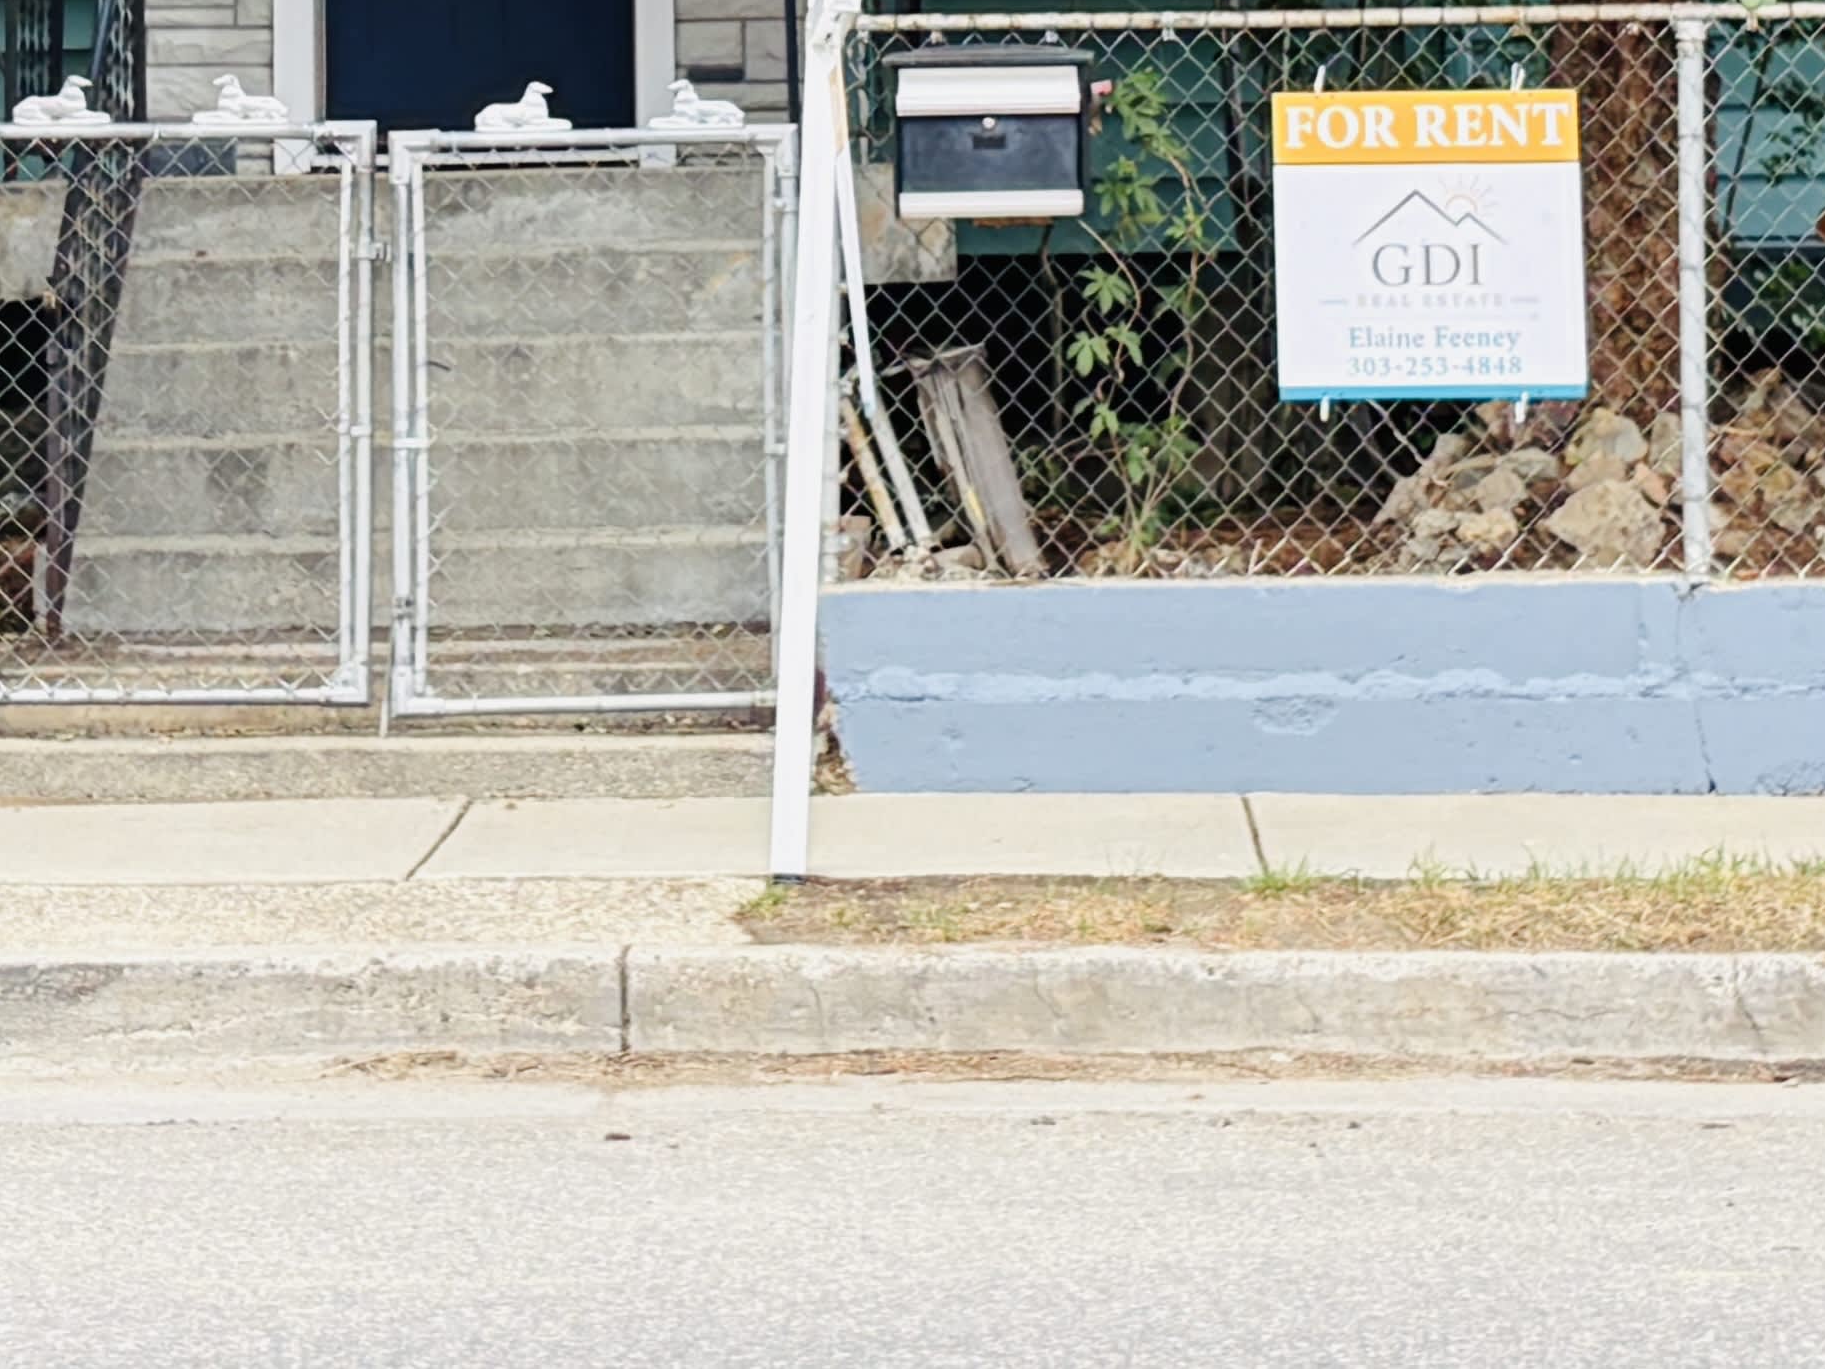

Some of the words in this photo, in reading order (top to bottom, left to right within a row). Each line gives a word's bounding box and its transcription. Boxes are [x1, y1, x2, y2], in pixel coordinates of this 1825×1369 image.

[1285, 105, 1398, 149] FOR
[1414, 103, 1570, 147] RENT
[1372, 243, 1483, 286] GDI
[1357, 294, 1413, 307] REAL
[1423, 293, 1504, 307] ESTATE
[1349, 326, 1425, 349] Elaine
[1435, 325, 1521, 352] Feeney
[1348, 356, 1523, 376] 303-253-4848
